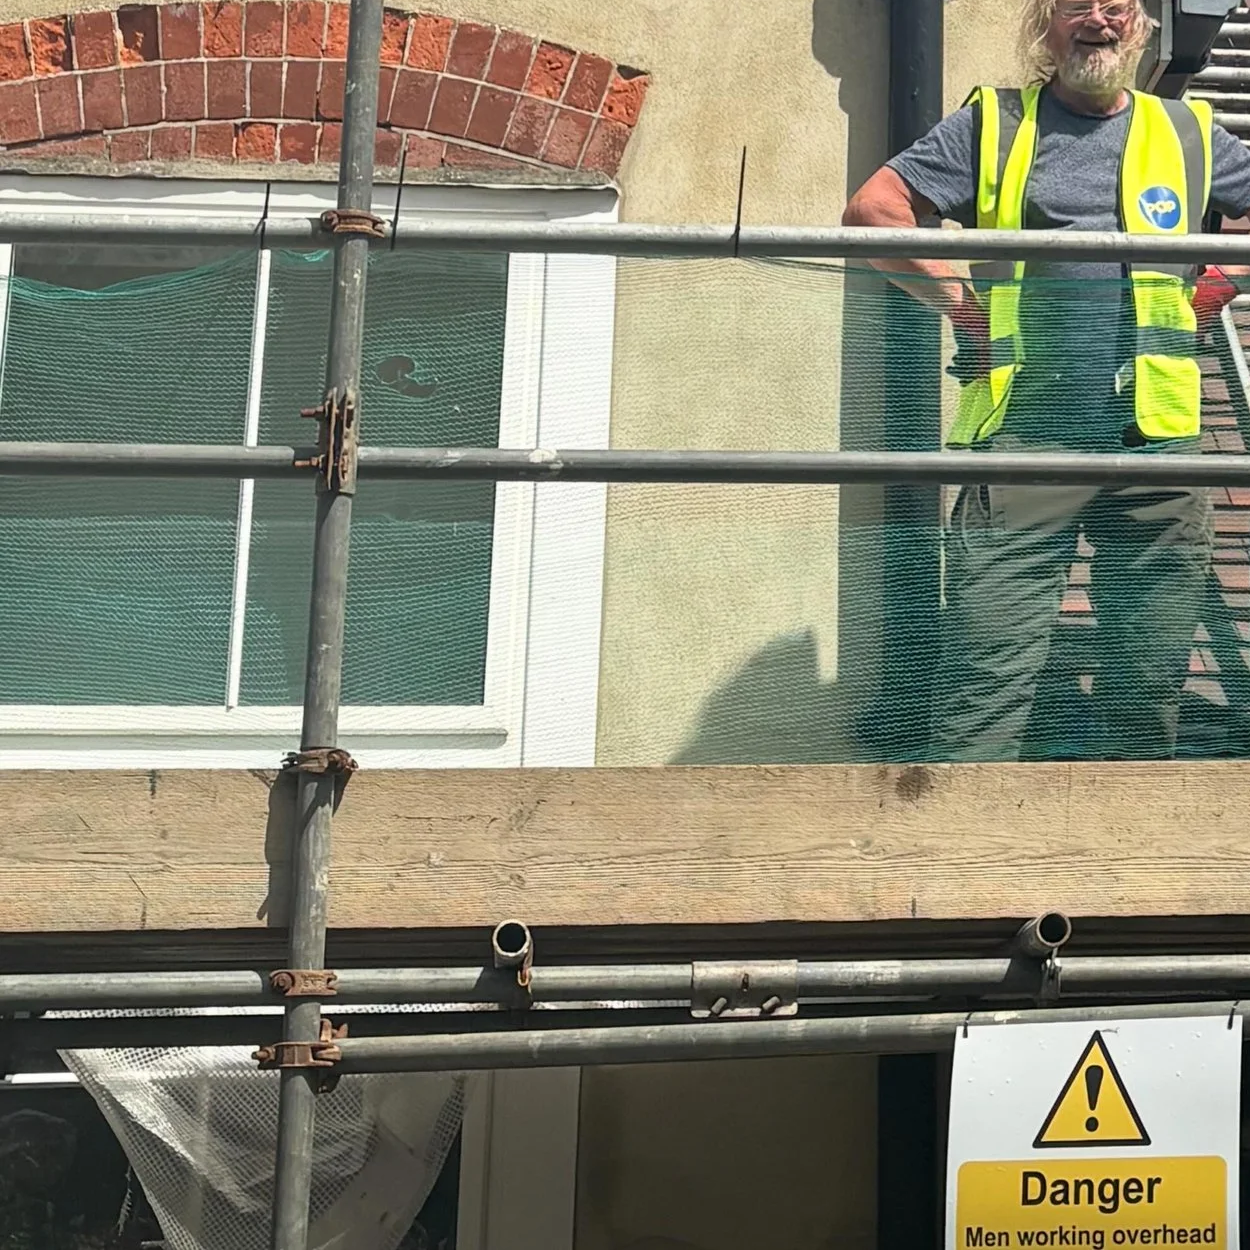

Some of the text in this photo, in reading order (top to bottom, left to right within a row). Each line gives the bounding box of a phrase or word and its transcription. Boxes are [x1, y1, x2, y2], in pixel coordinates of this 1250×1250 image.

[1021, 1171, 1162, 1214] Danger
[966, 1223, 1216, 1250] Men working overhead
